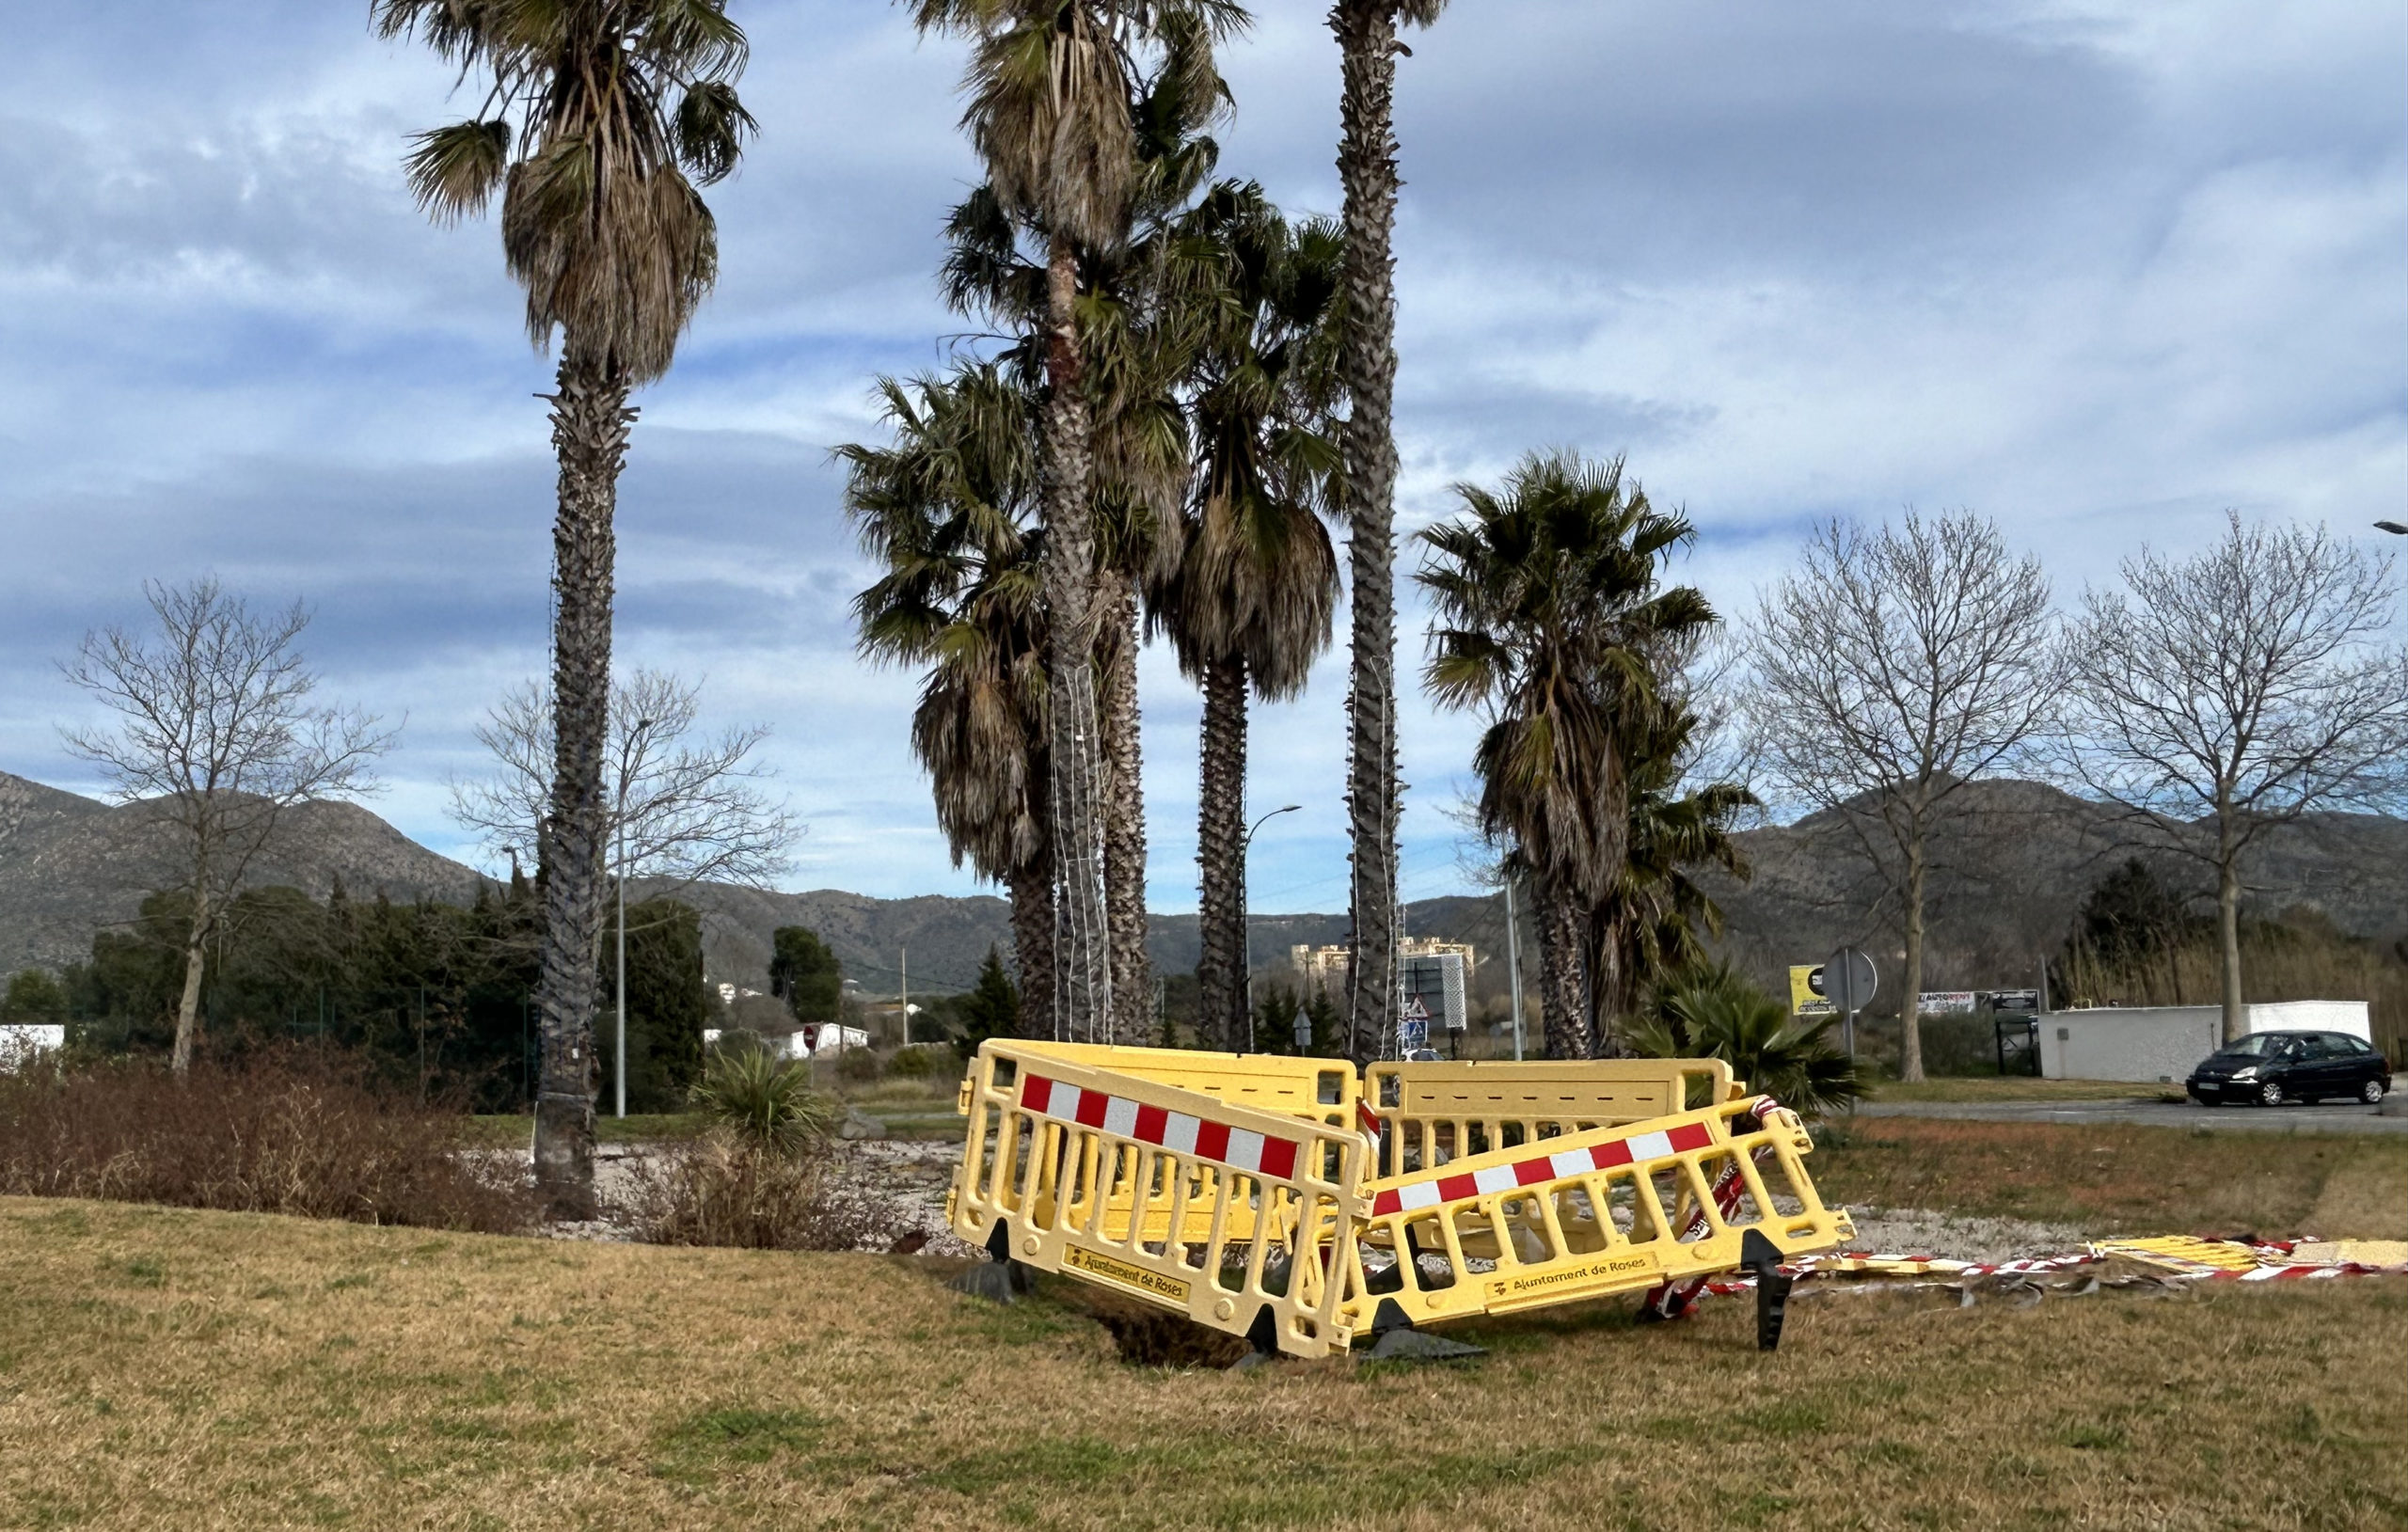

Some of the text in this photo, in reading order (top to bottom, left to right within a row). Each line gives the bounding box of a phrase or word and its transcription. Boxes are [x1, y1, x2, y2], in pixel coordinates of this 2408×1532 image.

[1085, 1256, 1182, 1297] Ajuntament de Roses
[1513, 1258, 1646, 1289] Ajuntament de Roses
